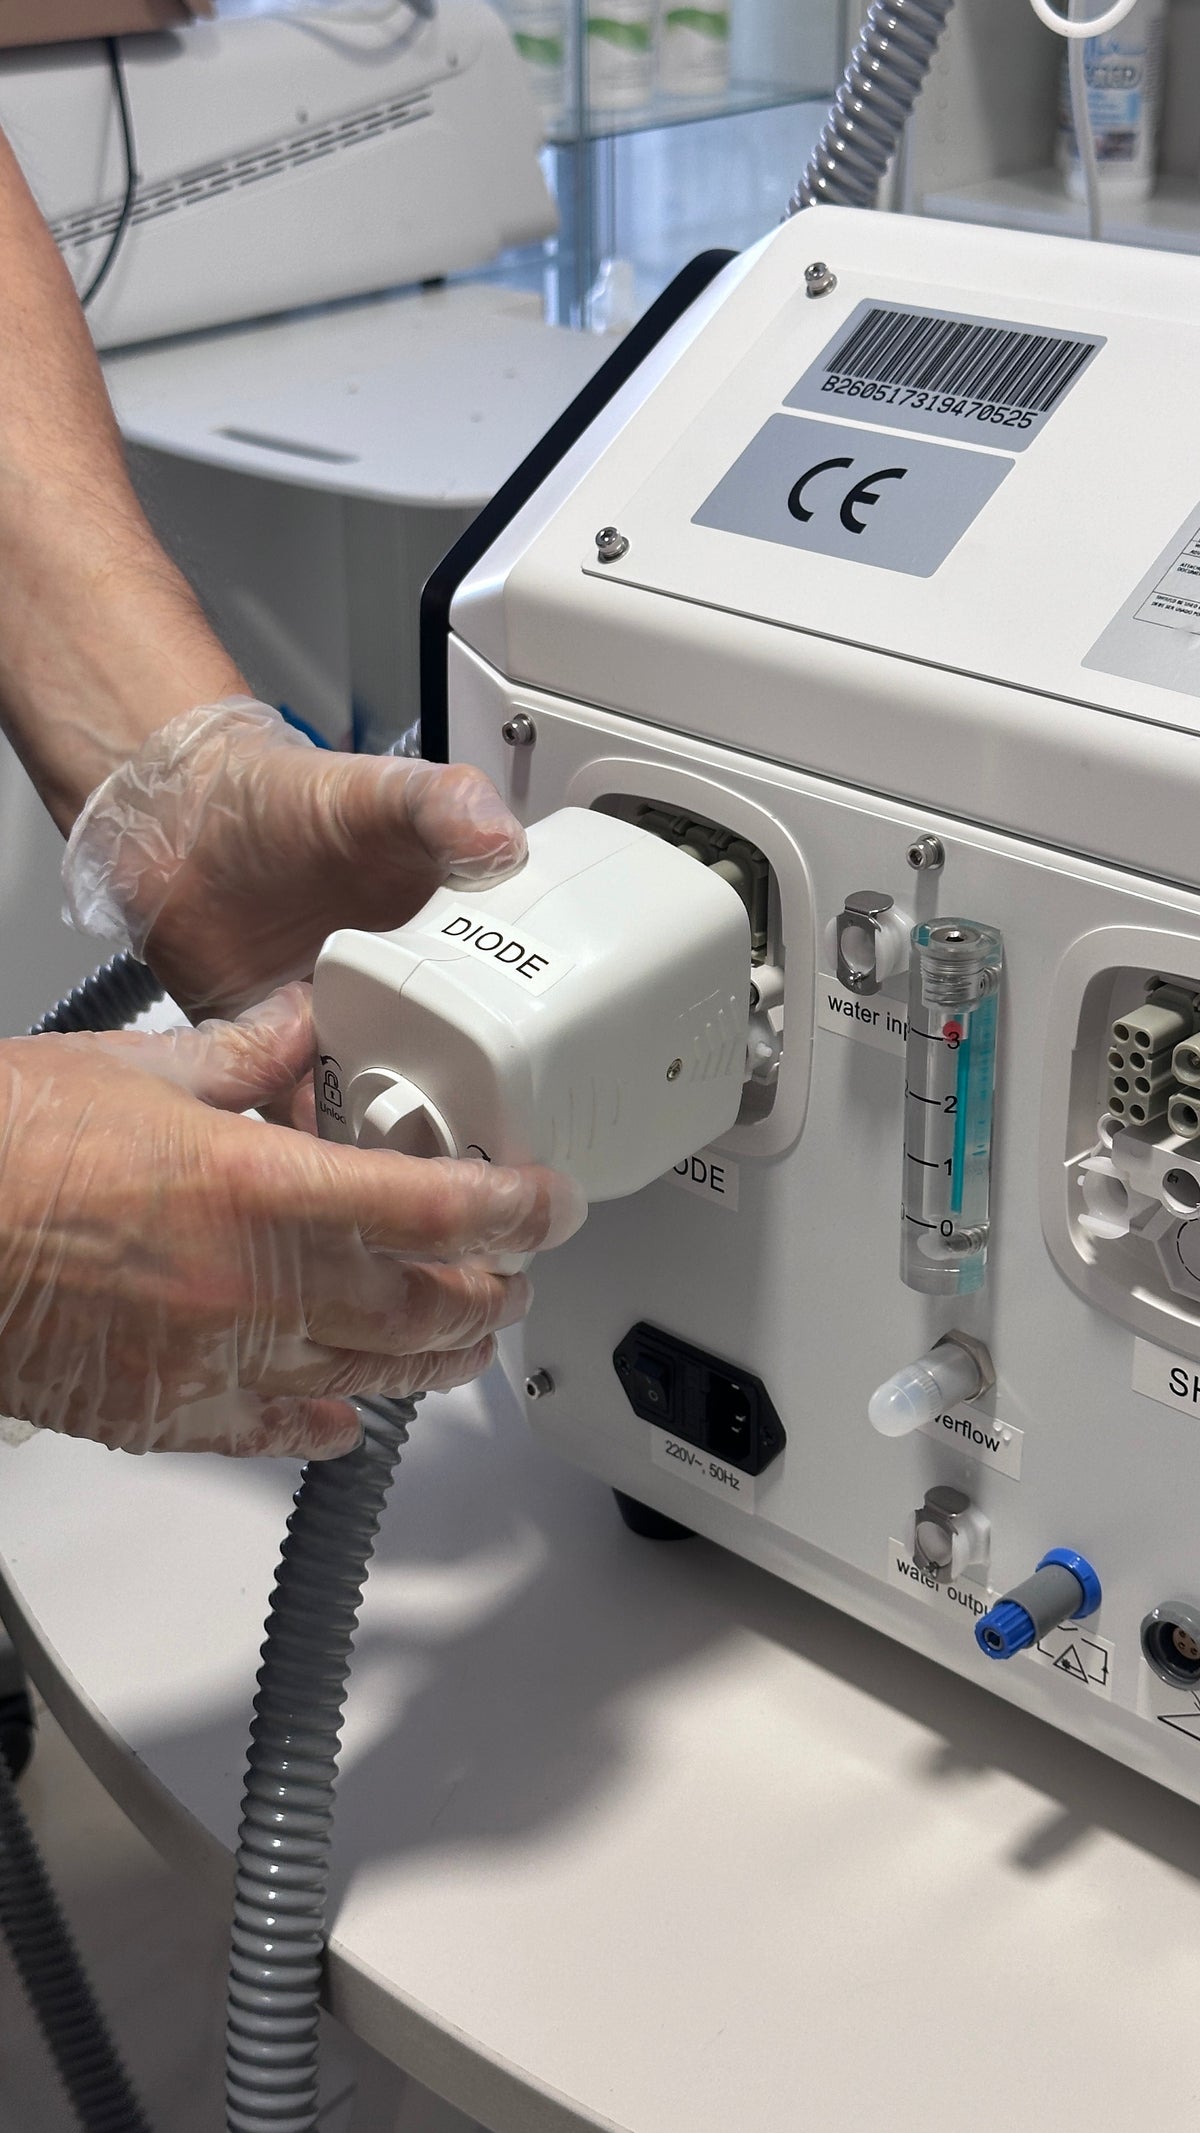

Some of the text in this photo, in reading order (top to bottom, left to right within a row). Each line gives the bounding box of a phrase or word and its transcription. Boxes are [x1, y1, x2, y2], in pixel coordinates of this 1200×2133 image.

[821, 375, 1038, 429] B260517319470525
[787, 457, 908, 534] CE
[441, 916, 549, 979] DIODE
[828, 995, 880, 1026] water
[947, 1031, 960, 1050] 3
[319, 1100, 347, 1125] Unloc
[943, 1095, 958, 1114] 2
[943, 1157, 952, 1176] 1
[940, 1219, 953, 1237] 0
[709, 1462, 741, 1492] 50Hz
